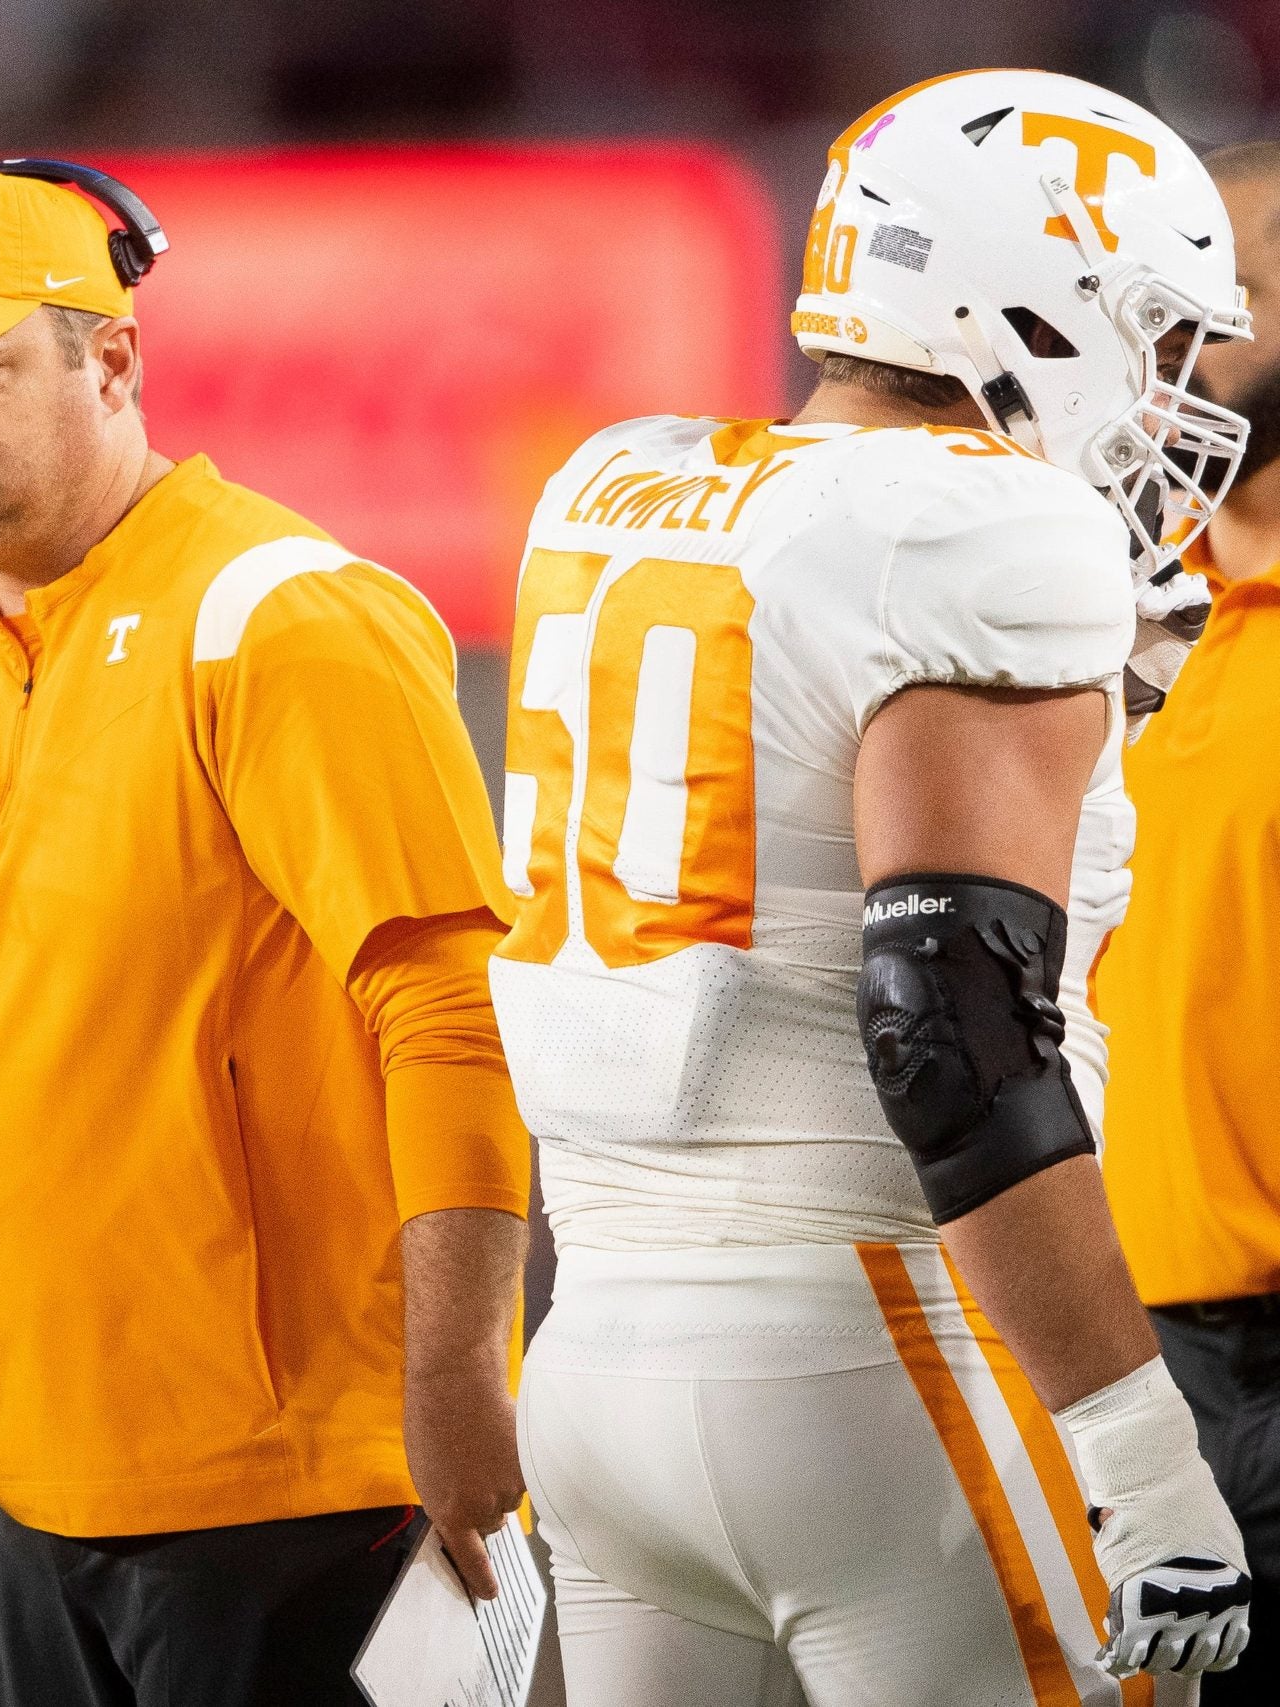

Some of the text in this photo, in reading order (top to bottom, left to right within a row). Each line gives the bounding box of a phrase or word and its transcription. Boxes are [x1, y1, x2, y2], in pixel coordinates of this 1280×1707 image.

[1022, 112, 1156, 253] T
[105, 612, 142, 666] T
[490, 547, 755, 969] 50
[864, 893, 952, 926] Mueller
